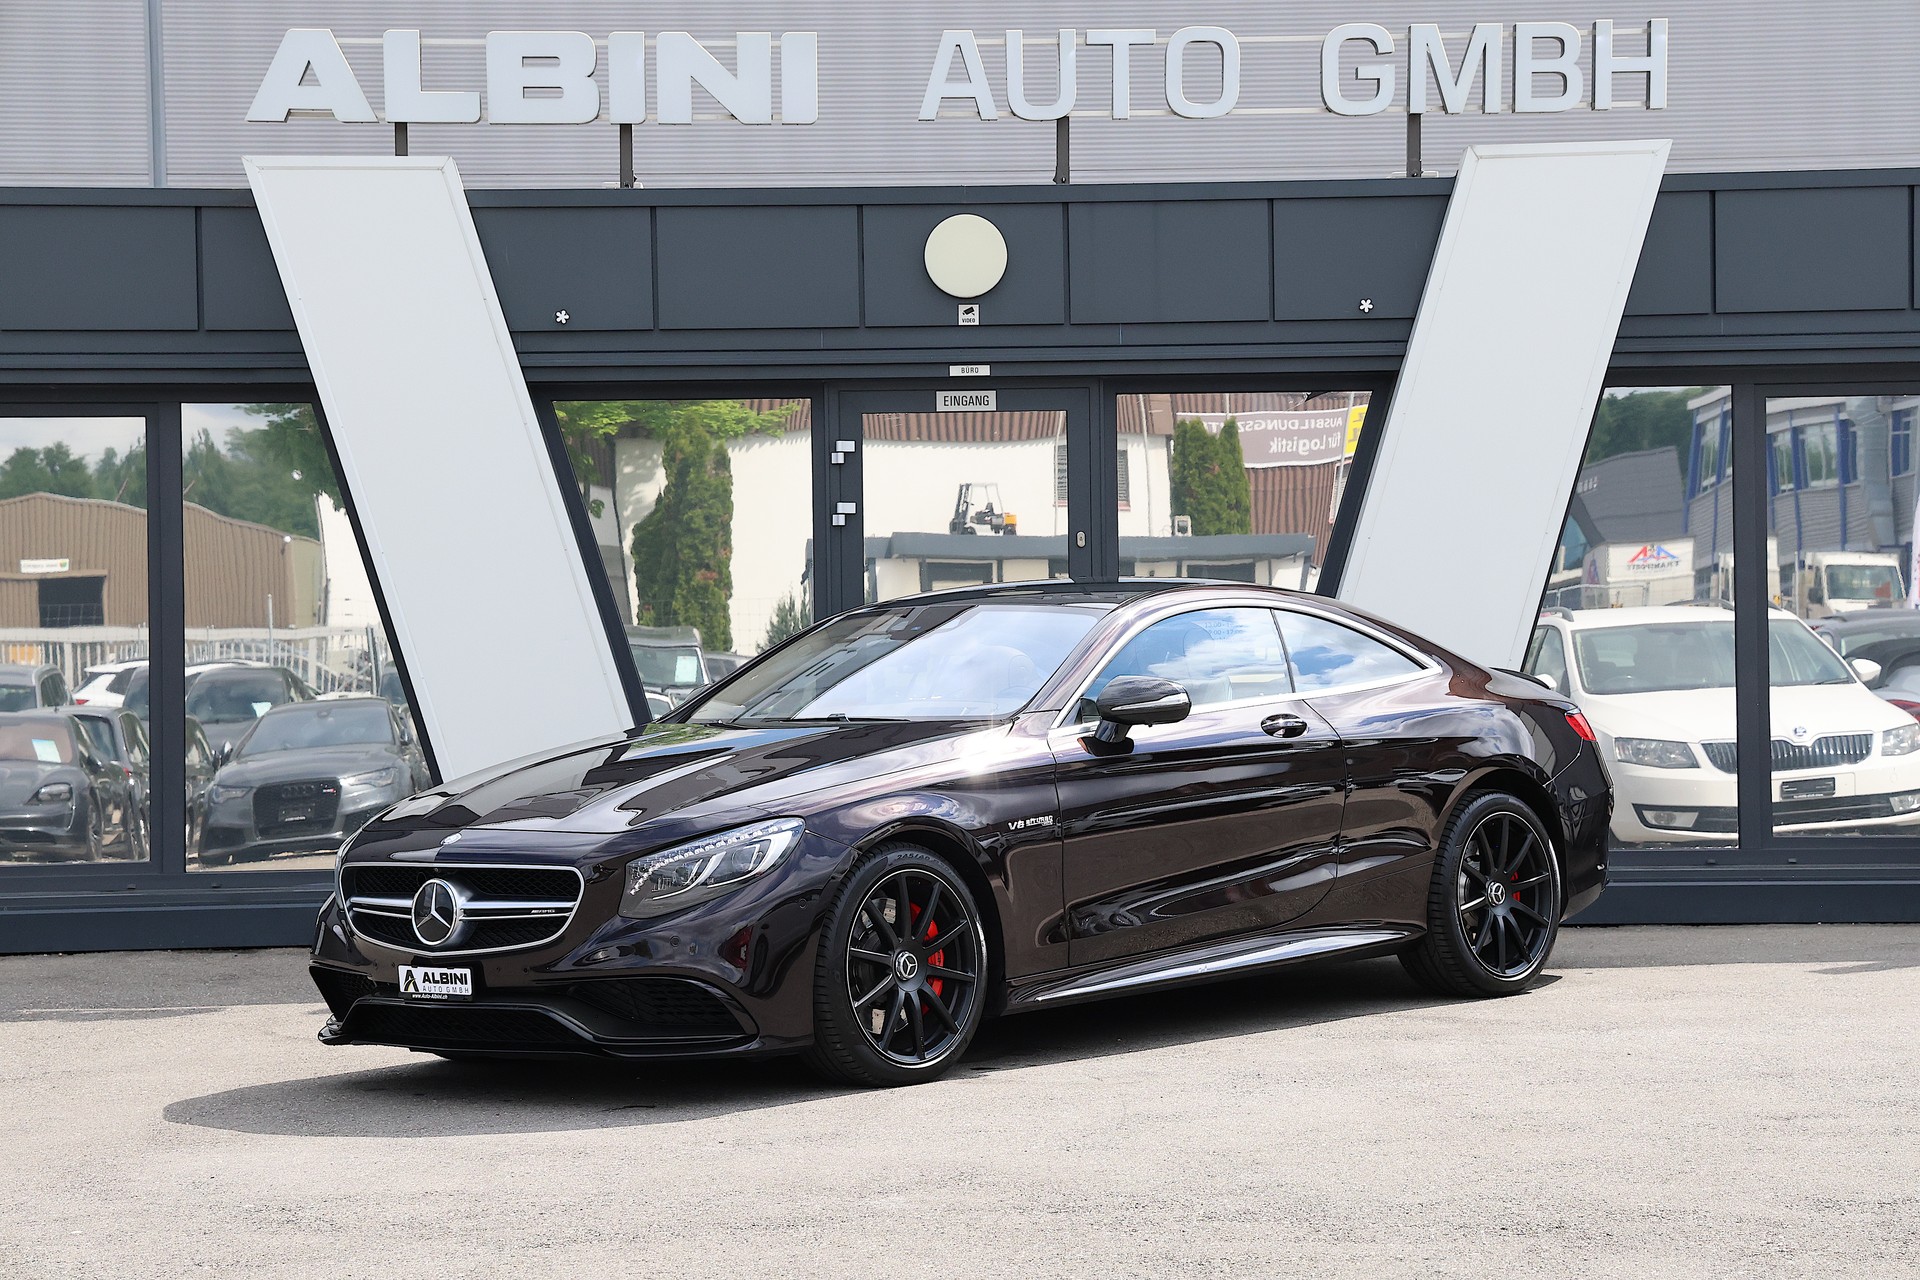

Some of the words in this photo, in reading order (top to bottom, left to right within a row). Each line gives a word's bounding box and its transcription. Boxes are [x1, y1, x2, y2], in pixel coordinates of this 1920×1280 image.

[245, 28, 818, 126] ALBINI
[918, 25, 1241, 121] AUTO
[1320, 18, 1669, 118] GMBH
[943, 395, 990, 407] EINGANG
[1008, 820, 1025, 830] V8
[422, 972, 468, 985] ALBINI
[422, 985, 443, 993] AUTO
[446, 986, 469, 994] GMBH
